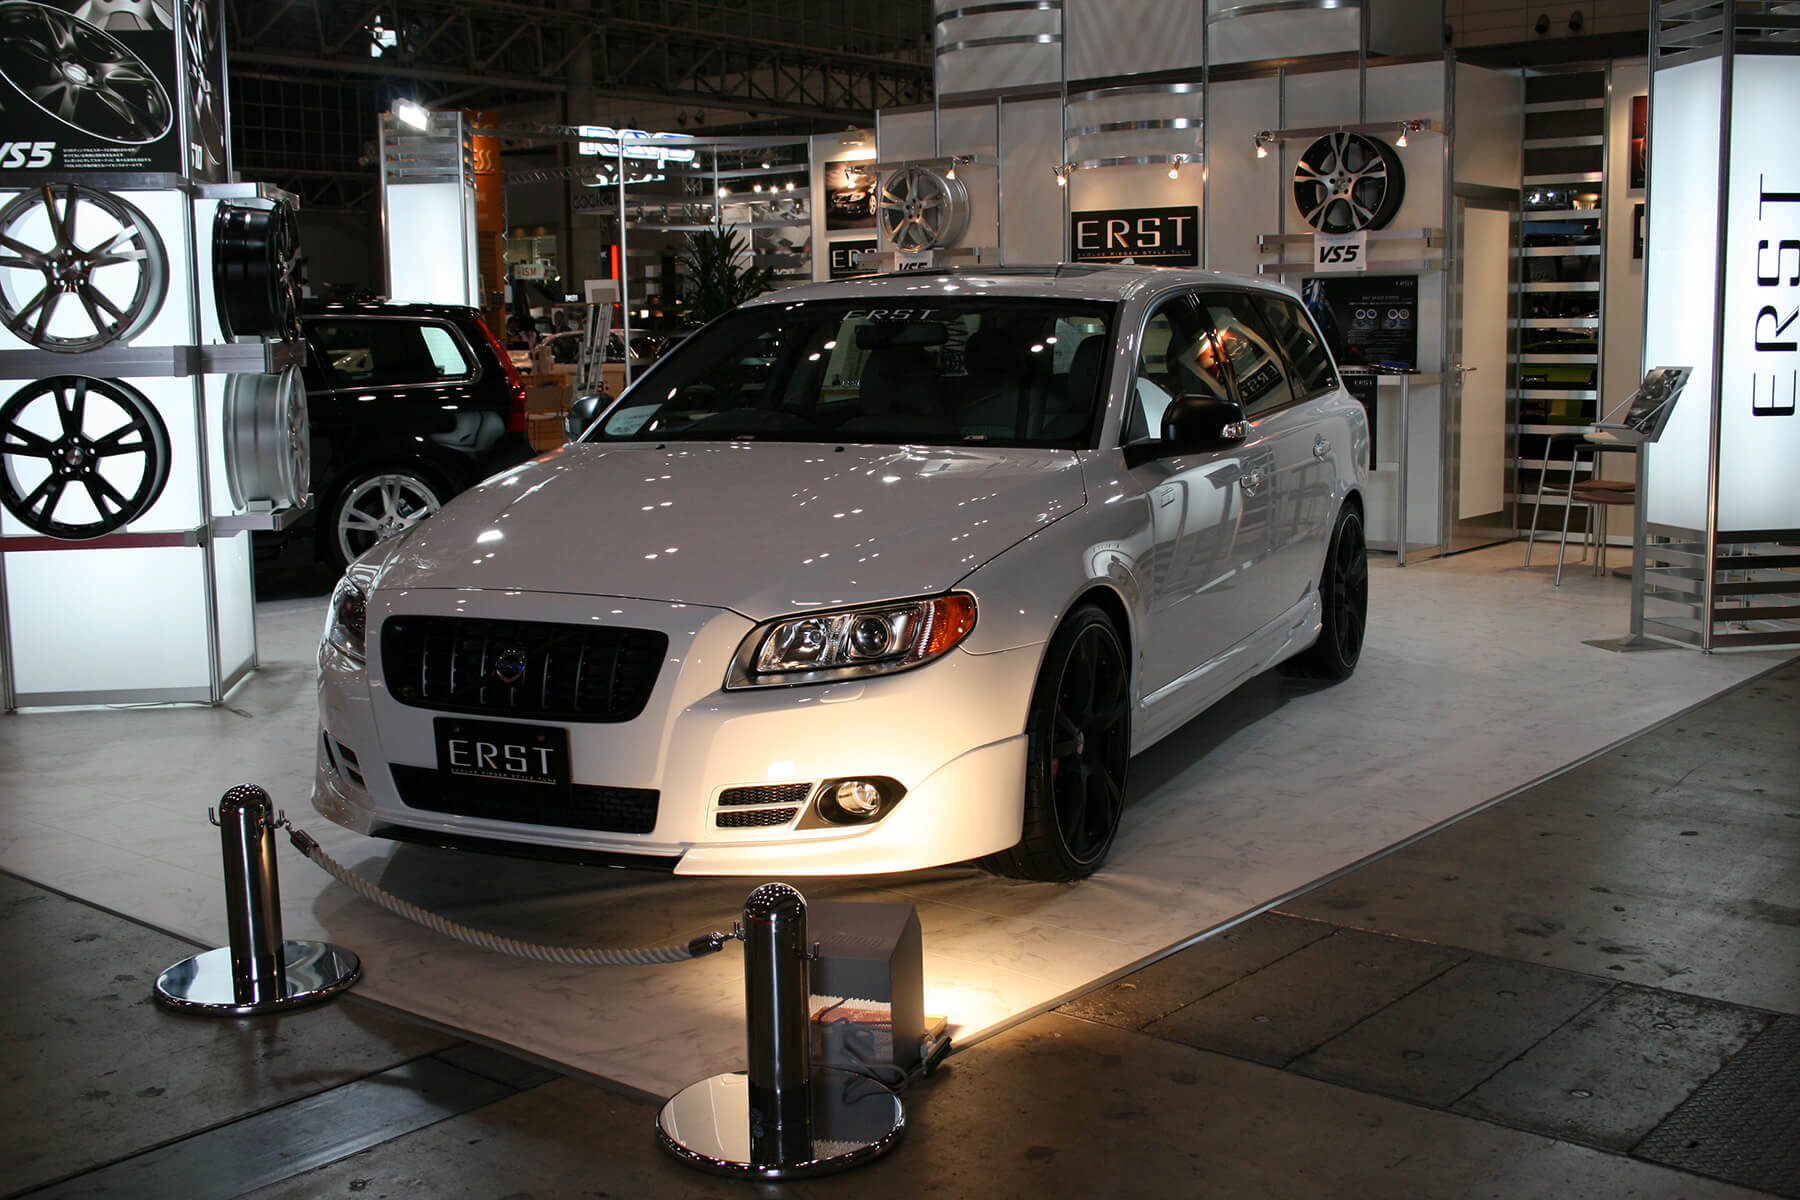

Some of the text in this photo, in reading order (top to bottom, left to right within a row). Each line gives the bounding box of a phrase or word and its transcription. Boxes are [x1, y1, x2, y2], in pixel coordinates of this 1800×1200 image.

[1077, 216, 1191, 249] ERST
[1319, 245, 1360, 263] VS5
[1752, 173, 1800, 416] ERST
[841, 309, 940, 322] ERST
[448, 739, 555, 775] ERST
